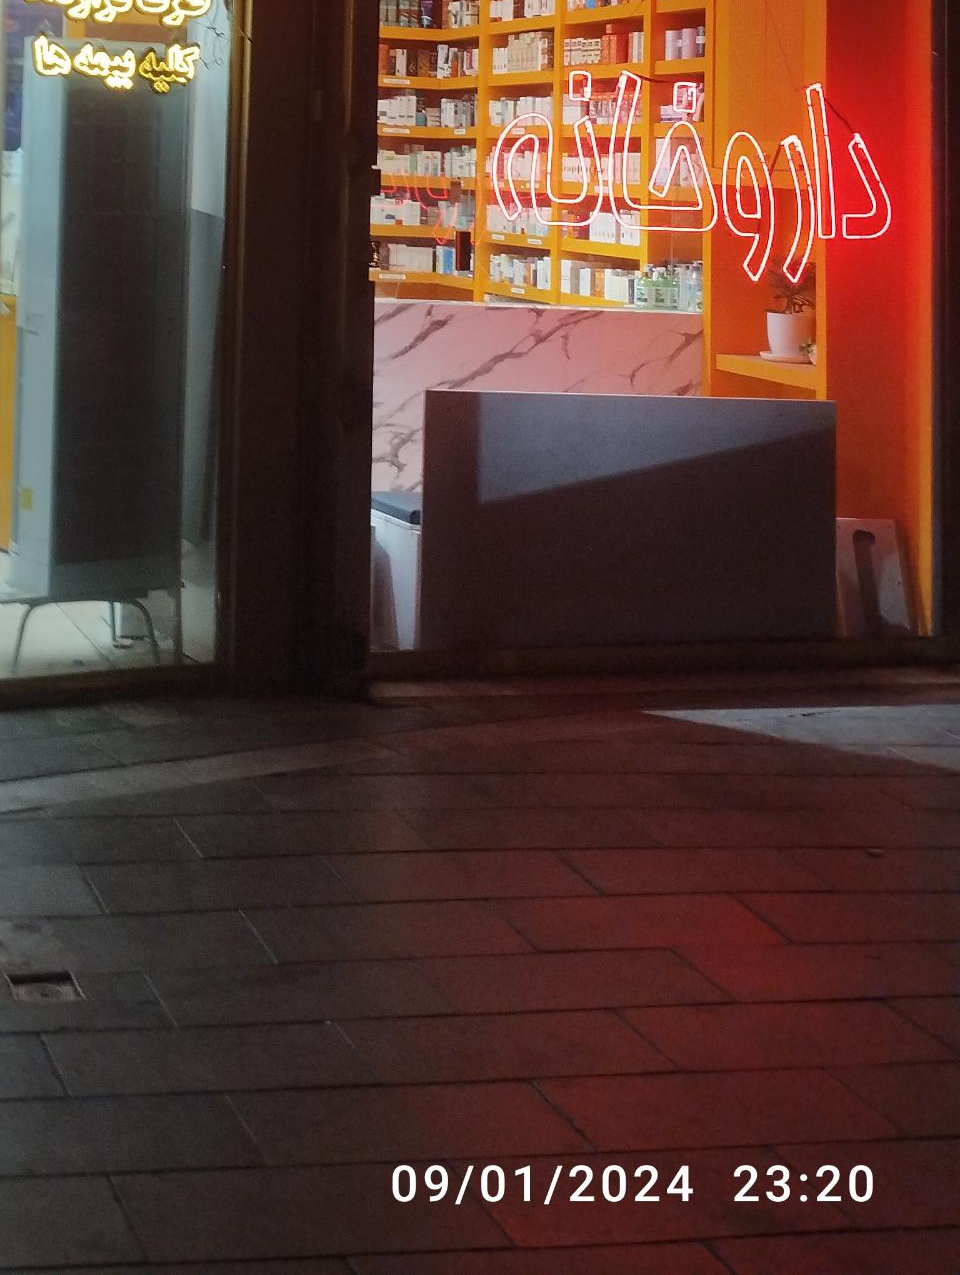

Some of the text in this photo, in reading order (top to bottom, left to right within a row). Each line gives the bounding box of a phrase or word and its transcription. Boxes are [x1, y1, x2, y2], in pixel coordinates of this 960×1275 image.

[34, 35, 201, 94] کلیه بیمه ها
[492, 69, 892, 284] داروخانه
